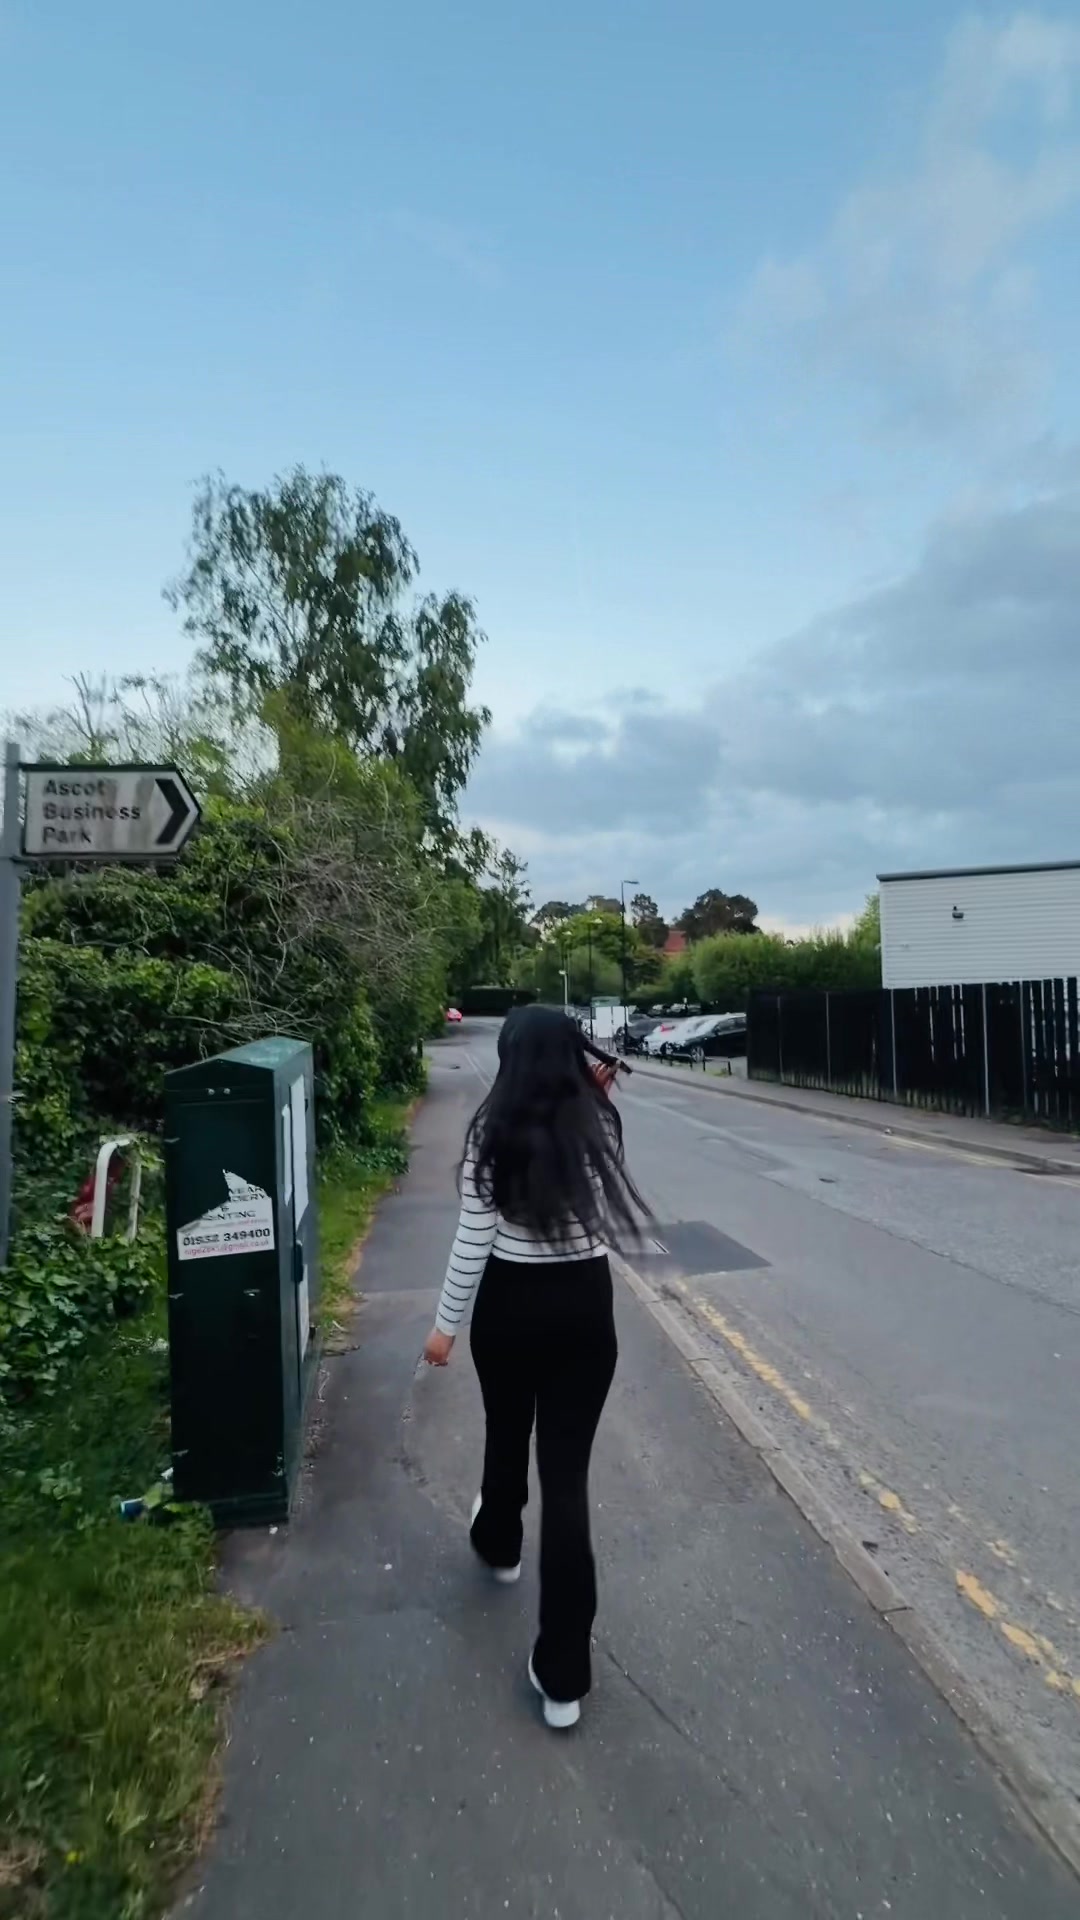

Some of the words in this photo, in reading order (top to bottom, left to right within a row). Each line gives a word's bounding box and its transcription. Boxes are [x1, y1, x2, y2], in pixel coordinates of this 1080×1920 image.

[44, 779, 106, 796] Ascot
[43, 802, 141, 820] Business
[43, 826, 92, 844] Park
[224, 1228, 270, 1242] 349400
